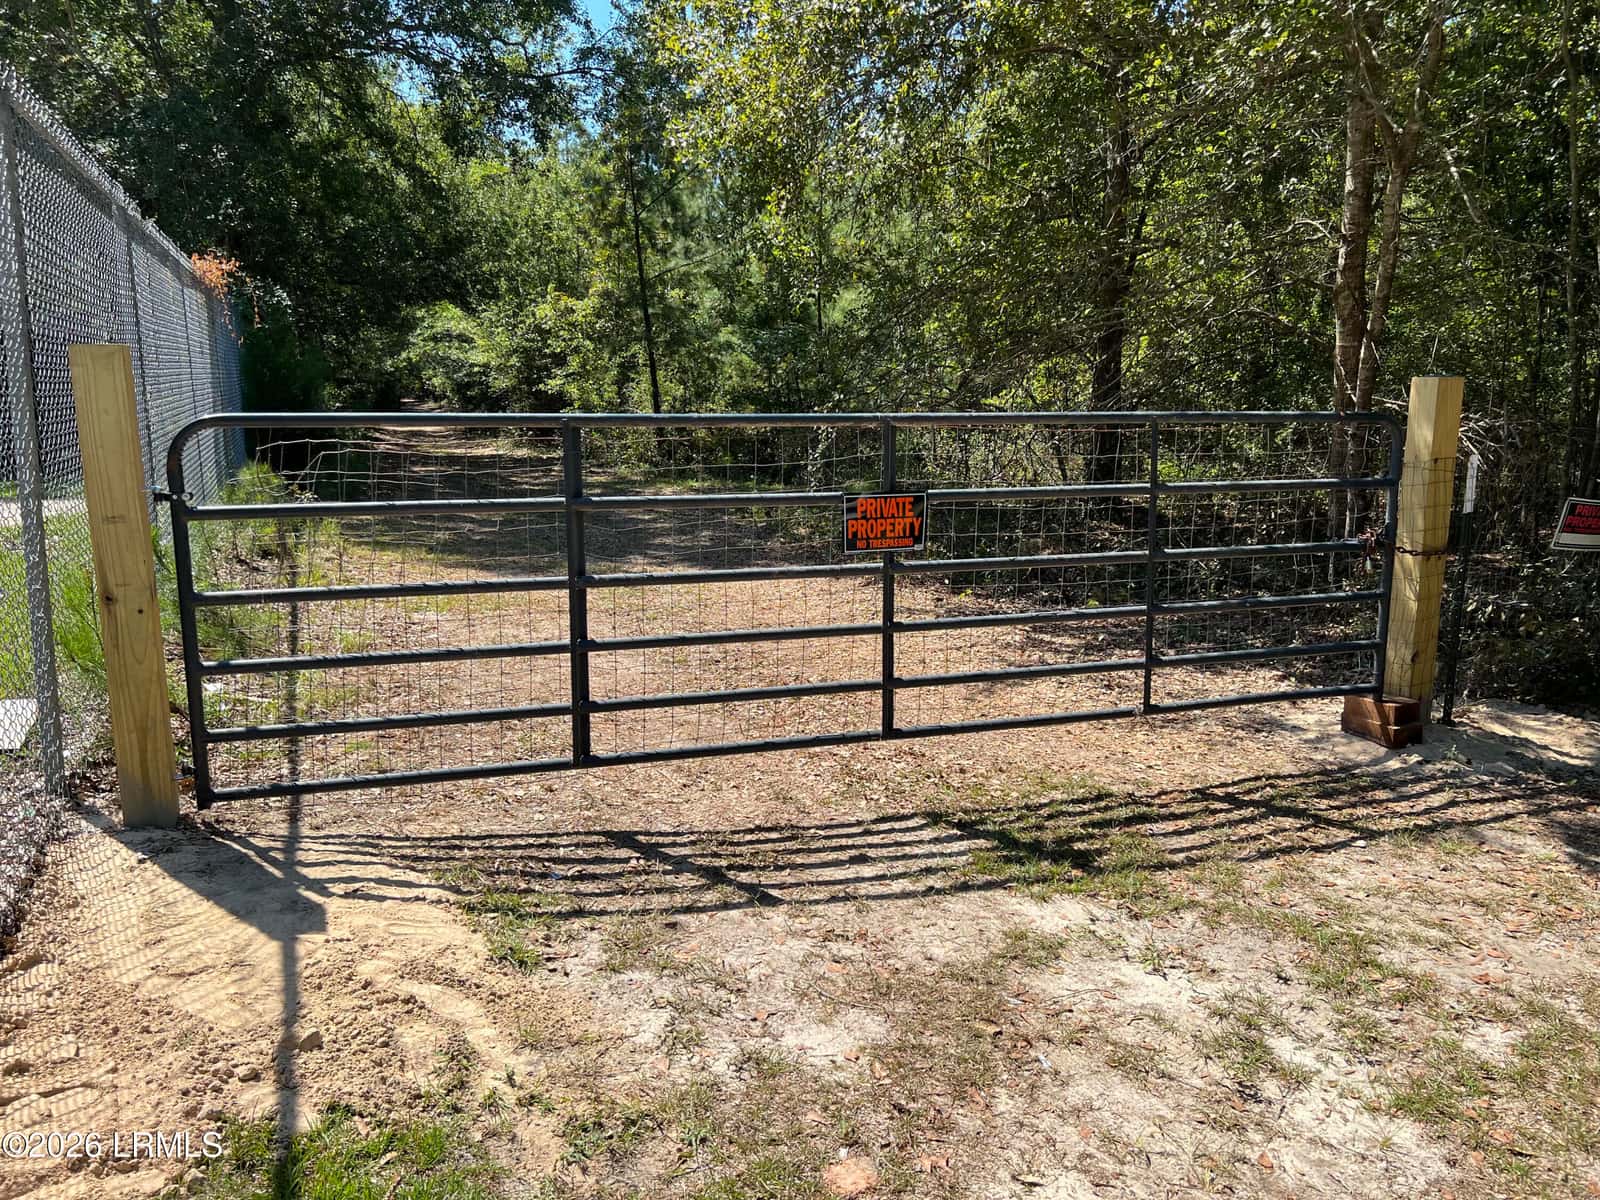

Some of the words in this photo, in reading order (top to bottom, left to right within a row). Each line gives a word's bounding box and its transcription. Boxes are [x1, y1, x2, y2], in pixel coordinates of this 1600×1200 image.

[856, 497, 914, 518] PRIVATE
[847, 517, 922, 540] PROPERTY
[856, 540, 867, 549] NO
[870, 537, 914, 549] TRESPASSING
